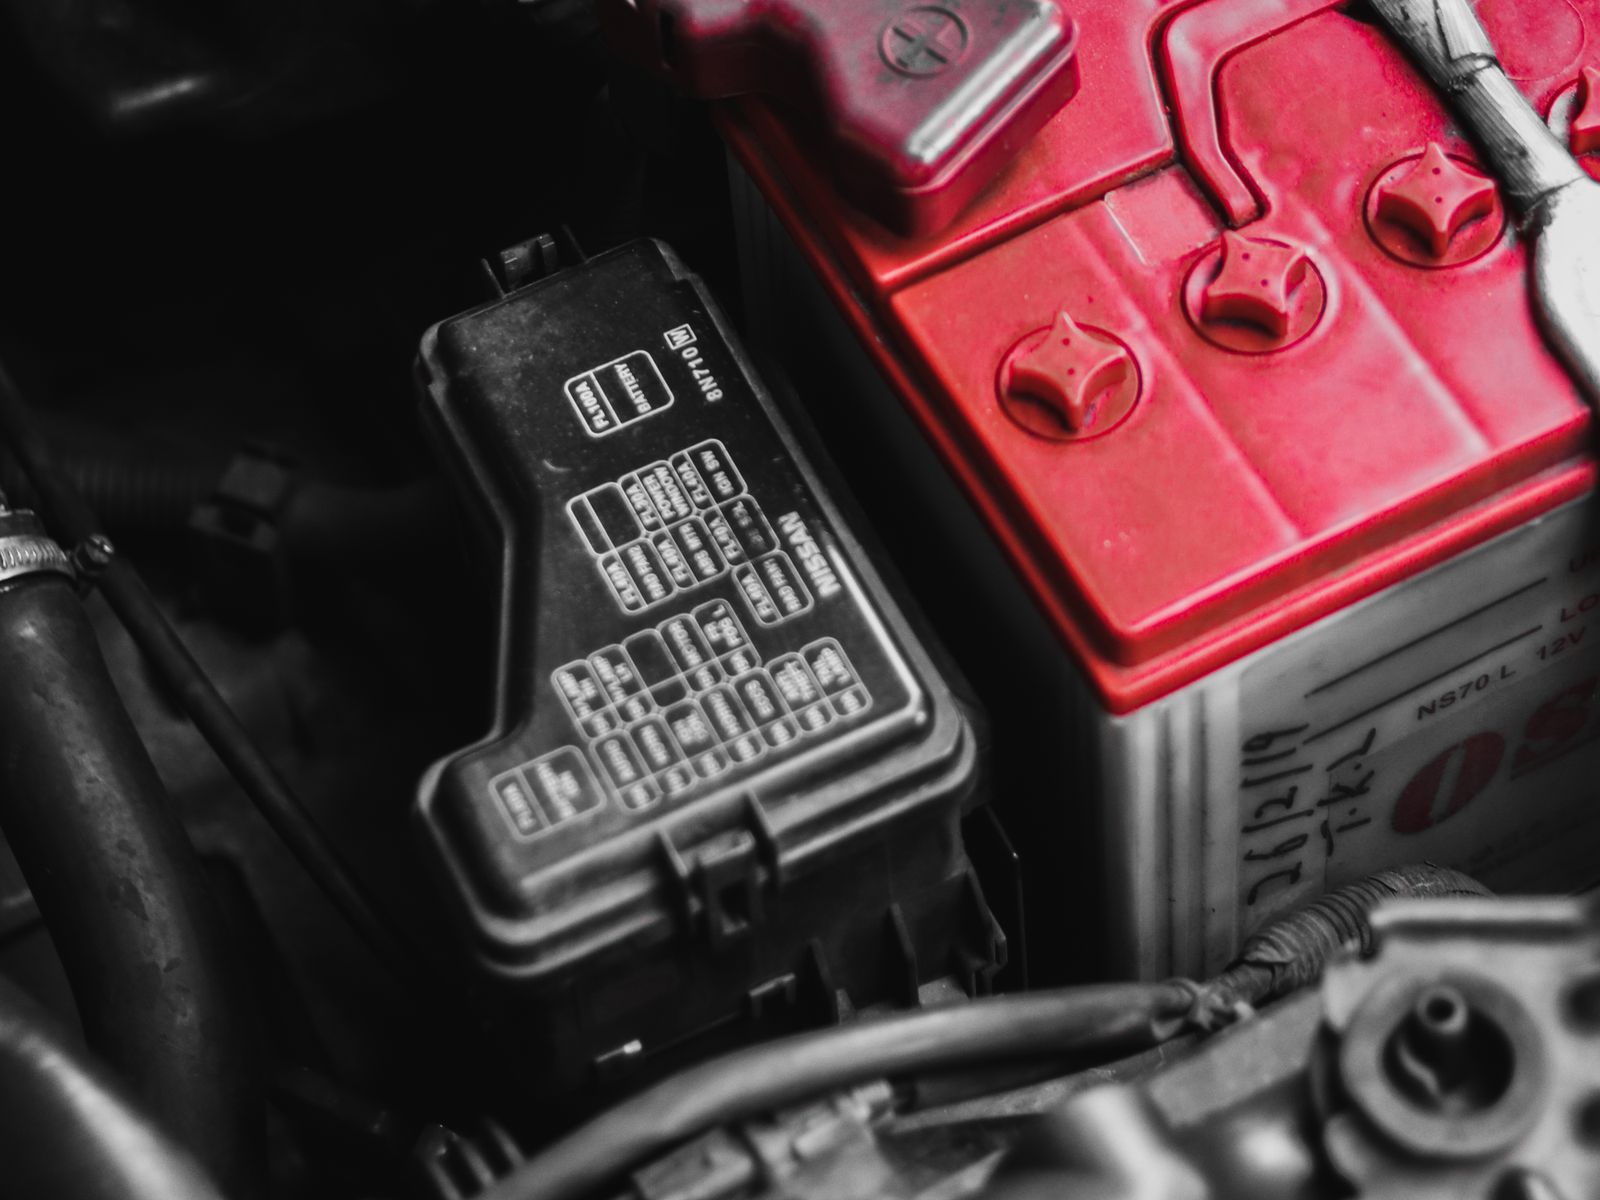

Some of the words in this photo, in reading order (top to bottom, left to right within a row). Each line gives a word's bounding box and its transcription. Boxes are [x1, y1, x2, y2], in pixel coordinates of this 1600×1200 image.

[613, 359, 652, 414] BATTERY
[680, 344, 724, 403] 8N710
[573, 379, 610, 430] FL100A
[675, 460, 708, 503] FL40A
[698, 447, 721, 472] SW
[711, 469, 735, 497] IGN
[641, 472, 677, 520] POWER
[653, 463, 691, 517] WINDOW
[656, 537, 690, 582] FL40A
[706, 516, 740, 560] FL40A
[776, 508, 842, 599] NISSAN
[1416, 674, 1490, 721] NS70
[1500, 665, 1518, 680] L
[1536, 626, 1588, 661] 12V
